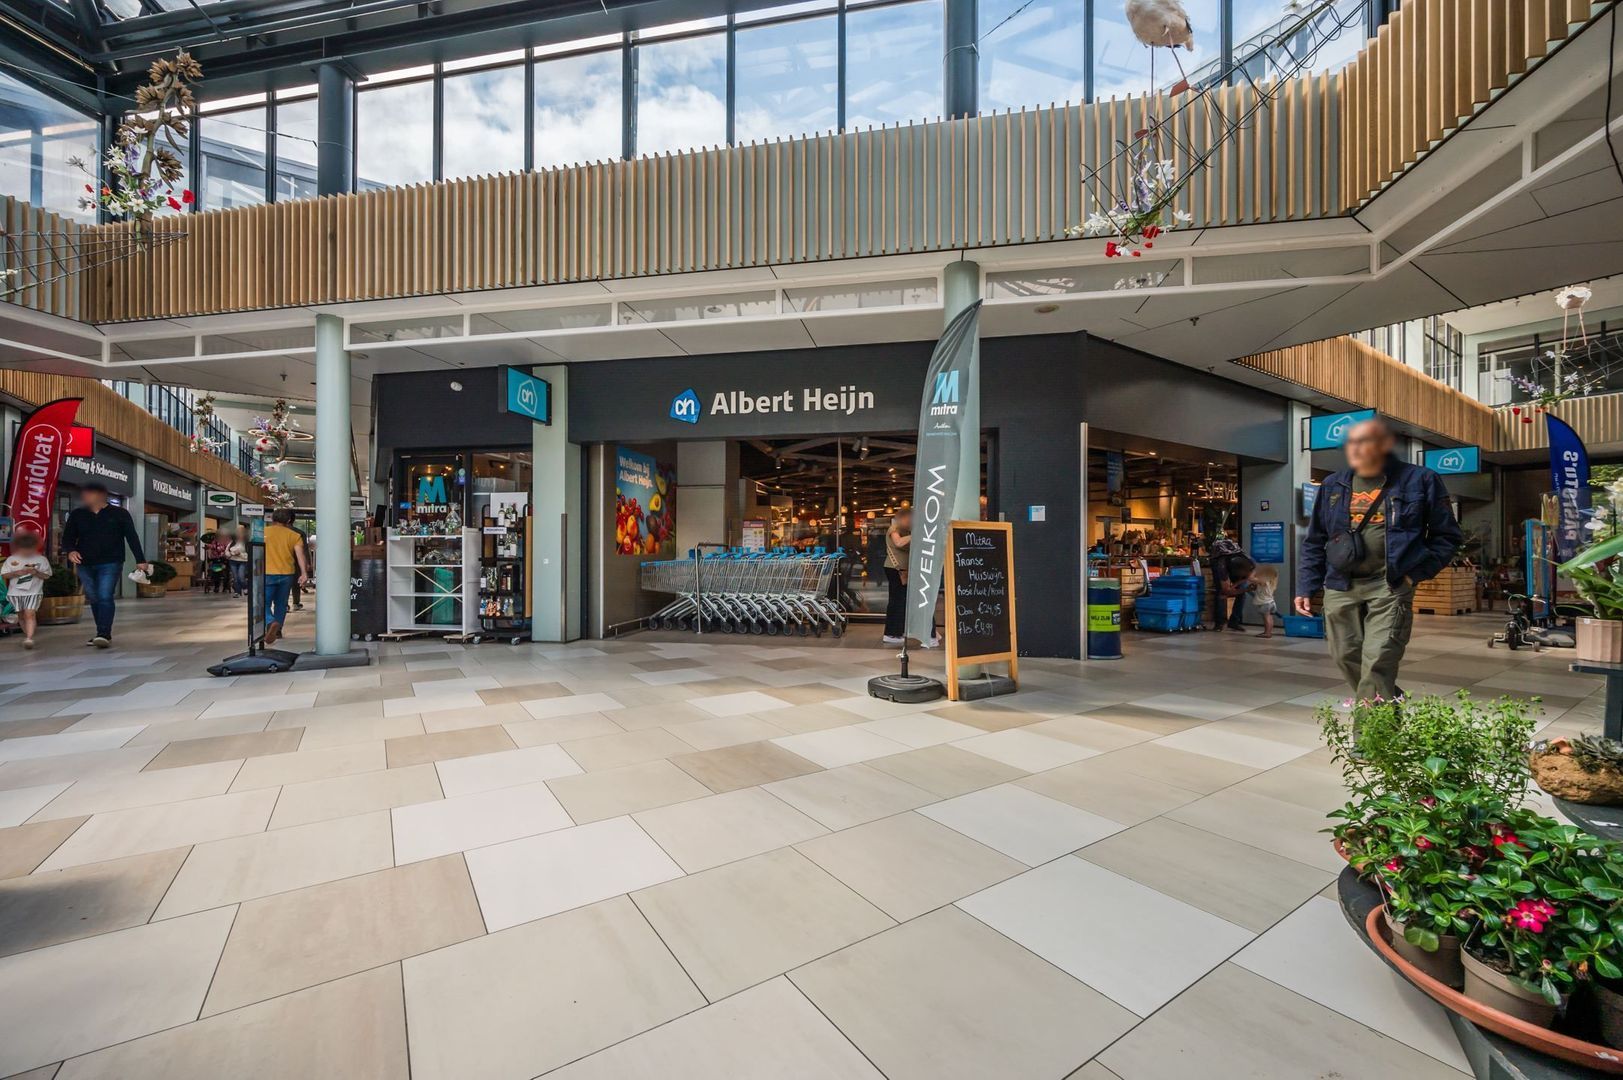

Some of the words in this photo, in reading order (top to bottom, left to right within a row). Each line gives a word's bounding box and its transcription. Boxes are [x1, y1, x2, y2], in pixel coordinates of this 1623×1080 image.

[711, 390, 793, 415] Albert
[803, 386, 875, 415] Heijn
[931, 404, 958, 416] mitra
[65, 456, 90, 475] Kleding
[619, 456, 643, 472] Welkom
[20, 433, 54, 518] Kruidvat
[619, 469, 638, 485] Albert
[417, 504, 447, 513] mitra
[918, 464, 947, 609] WELKOM
